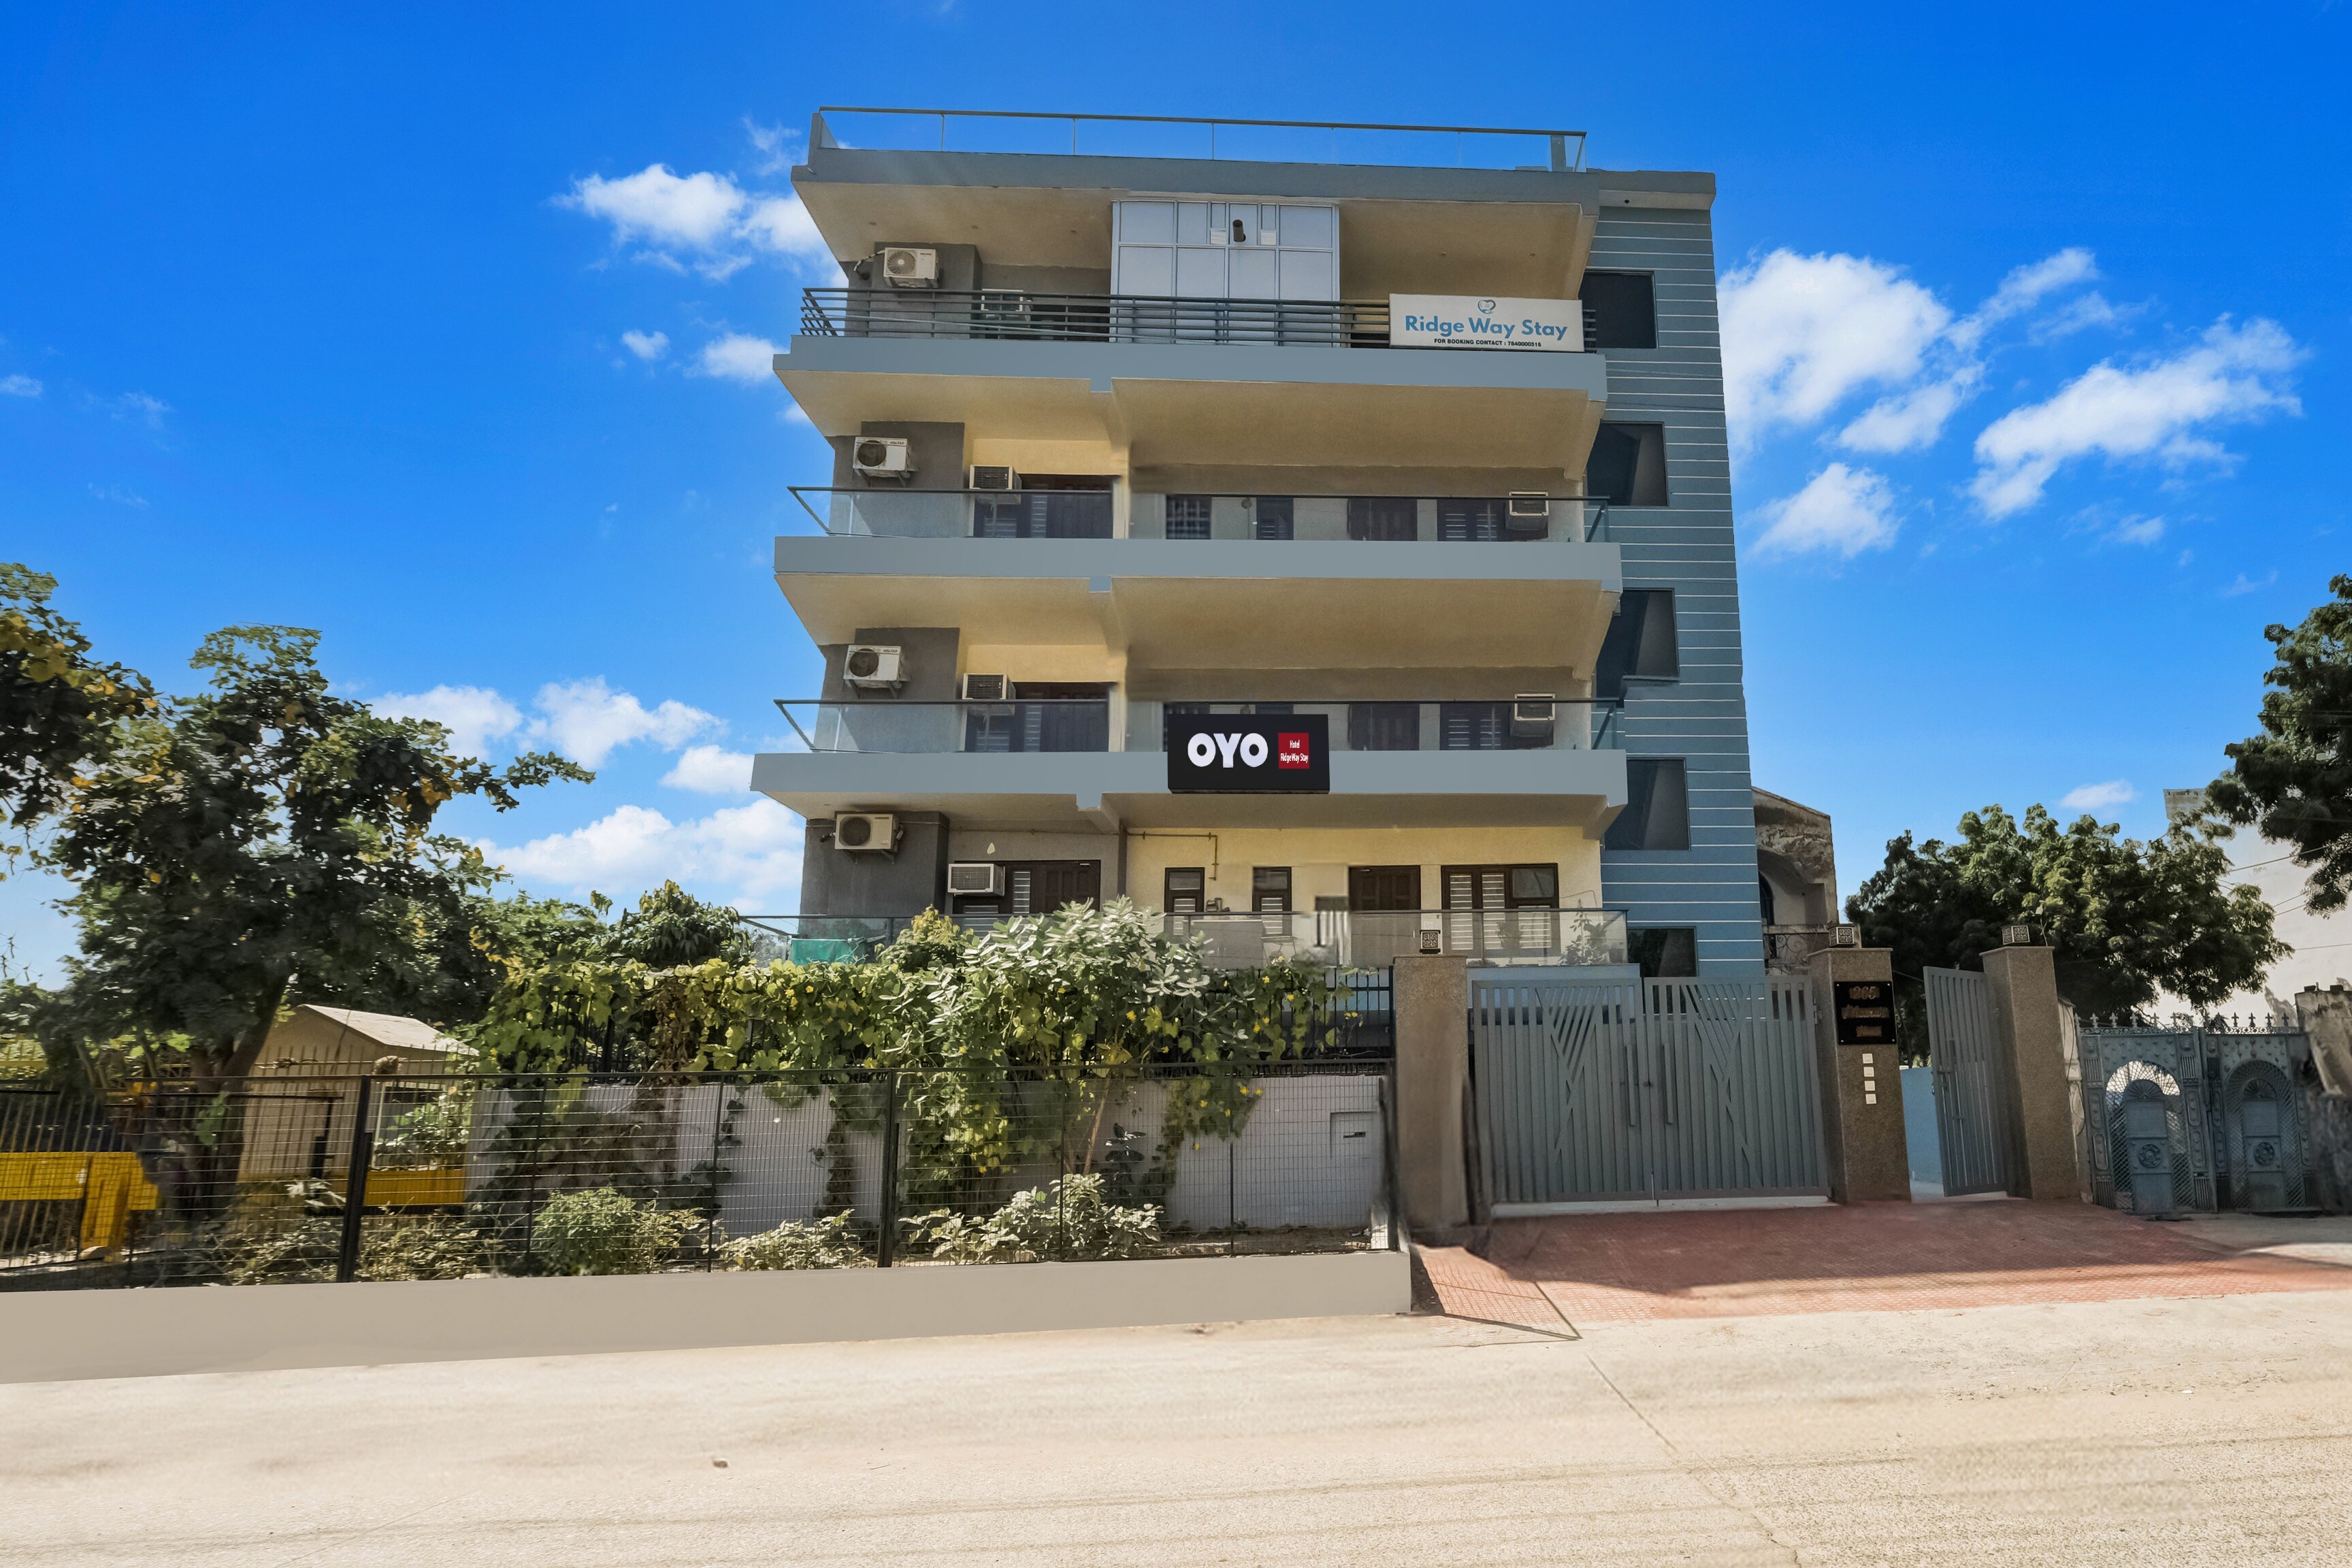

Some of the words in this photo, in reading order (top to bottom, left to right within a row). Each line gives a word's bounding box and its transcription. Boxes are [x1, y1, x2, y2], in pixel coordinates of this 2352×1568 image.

[1405, 315, 1465, 337] Ridge
[1468, 317, 1516, 339] Way
[1521, 319, 1567, 340] Stay
[1188, 733, 1269, 768] OYO
[1290, 739, 1300, 749] Hotel
[1300, 753, 1309, 764] Stay
